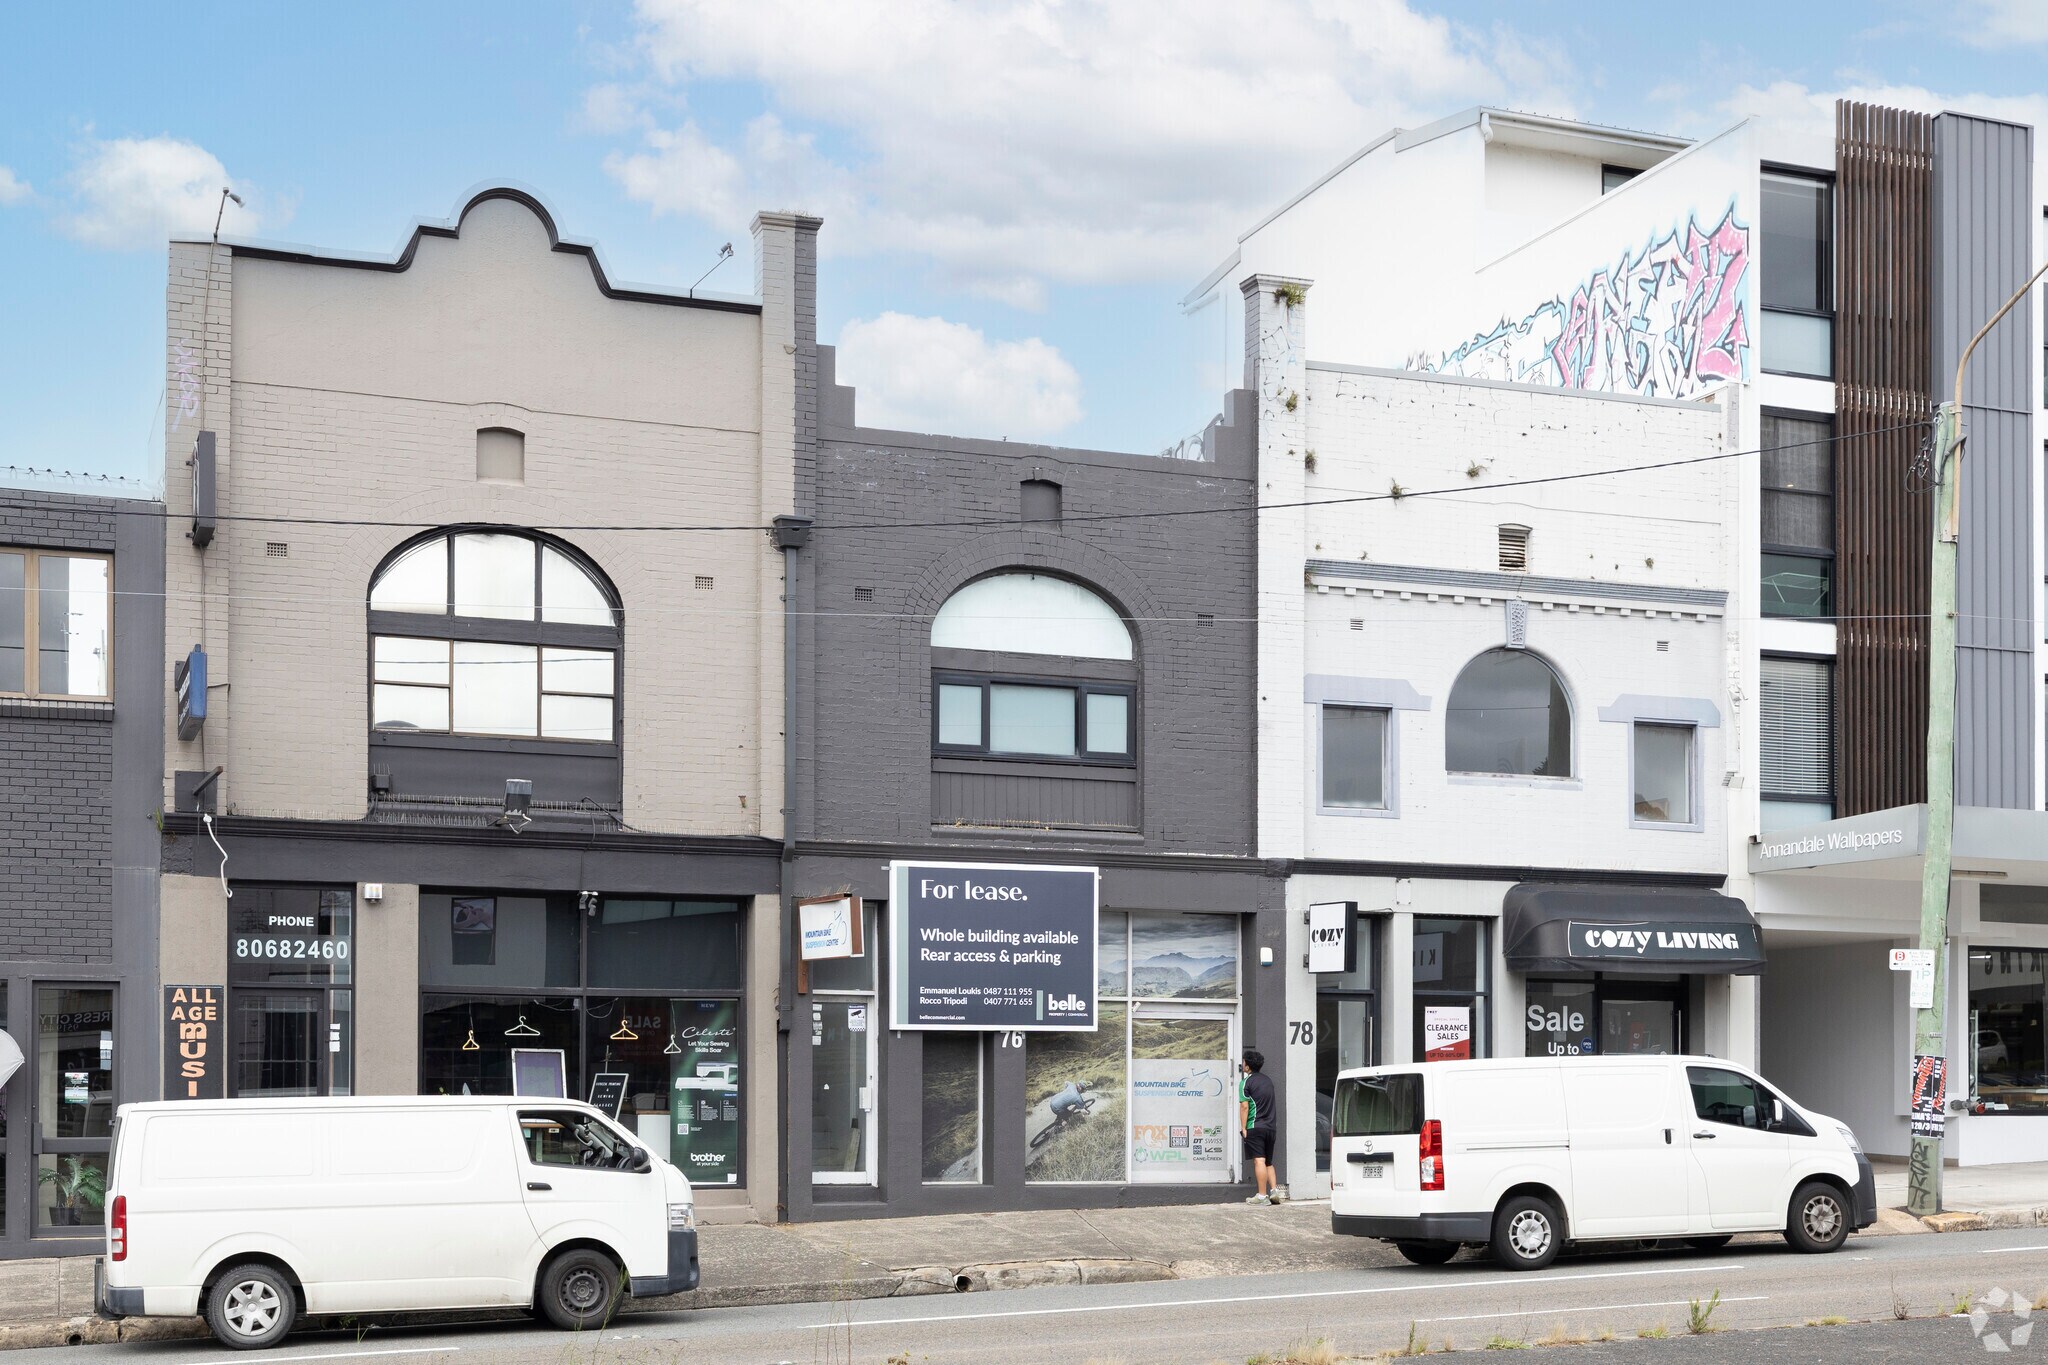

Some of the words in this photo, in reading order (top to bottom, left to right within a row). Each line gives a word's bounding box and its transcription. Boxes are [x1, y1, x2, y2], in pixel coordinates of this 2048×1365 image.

[1760, 835, 1825, 860] Annandale
[1828, 829, 1903, 851] Wallpapers
[921, 879, 959, 899] For
[964, 880, 1028, 901] lease.
[268, 915, 315, 927] PHONE
[920, 927, 965, 942] Whole
[967, 928, 1020, 946] building
[1022, 930, 1079, 944] available
[1311, 927, 1344, 944] COZY
[1584, 929, 1652, 954] COZY
[1656, 931, 1740, 950] LIVING
[236, 938, 348, 959] 80682460
[920, 947, 951, 962] Rear
[953, 950, 996, 962] access
[999, 950, 1010, 963] &
[1013, 950, 1062, 966] parking
[171, 988, 217, 1003] ALL
[919, 987, 957, 995] Emmanuel
[958, 987, 981, 995] Loukis
[983, 987, 1001, 995] 0487
[1003, 988, 1017, 996] 111
[1019, 988, 1033, 996] 955
[919, 996, 942, 1005] Rocco
[942, 997, 968, 1006] Tripodi
[983, 997, 1001, 1006] 0407
[1002, 998, 1018, 1006] 771
[1019, 998, 1033, 1006] 655
[1048, 993, 1086, 1011] belle
[170, 1005, 217, 1021] AGE
[1526, 1004, 1585, 1032] Sale
[1289, 1021, 1314, 1046] 78
[1426, 1023, 1468, 1032] CLEARANCE
[709, 1040, 730, 1048] Sewing
[1000, 1030, 1023, 1048] 76
[1437, 1032, 1459, 1040] SALES
[1547, 1041, 1565, 1056] Up
[1567, 1042, 1580, 1055] to
[179, 1022, 208, 1097] MUSI
[1134, 1125, 1168, 1141] FOX
[690, 1152, 726, 1162] brother
[1150, 1150, 1188, 1160] WPL
